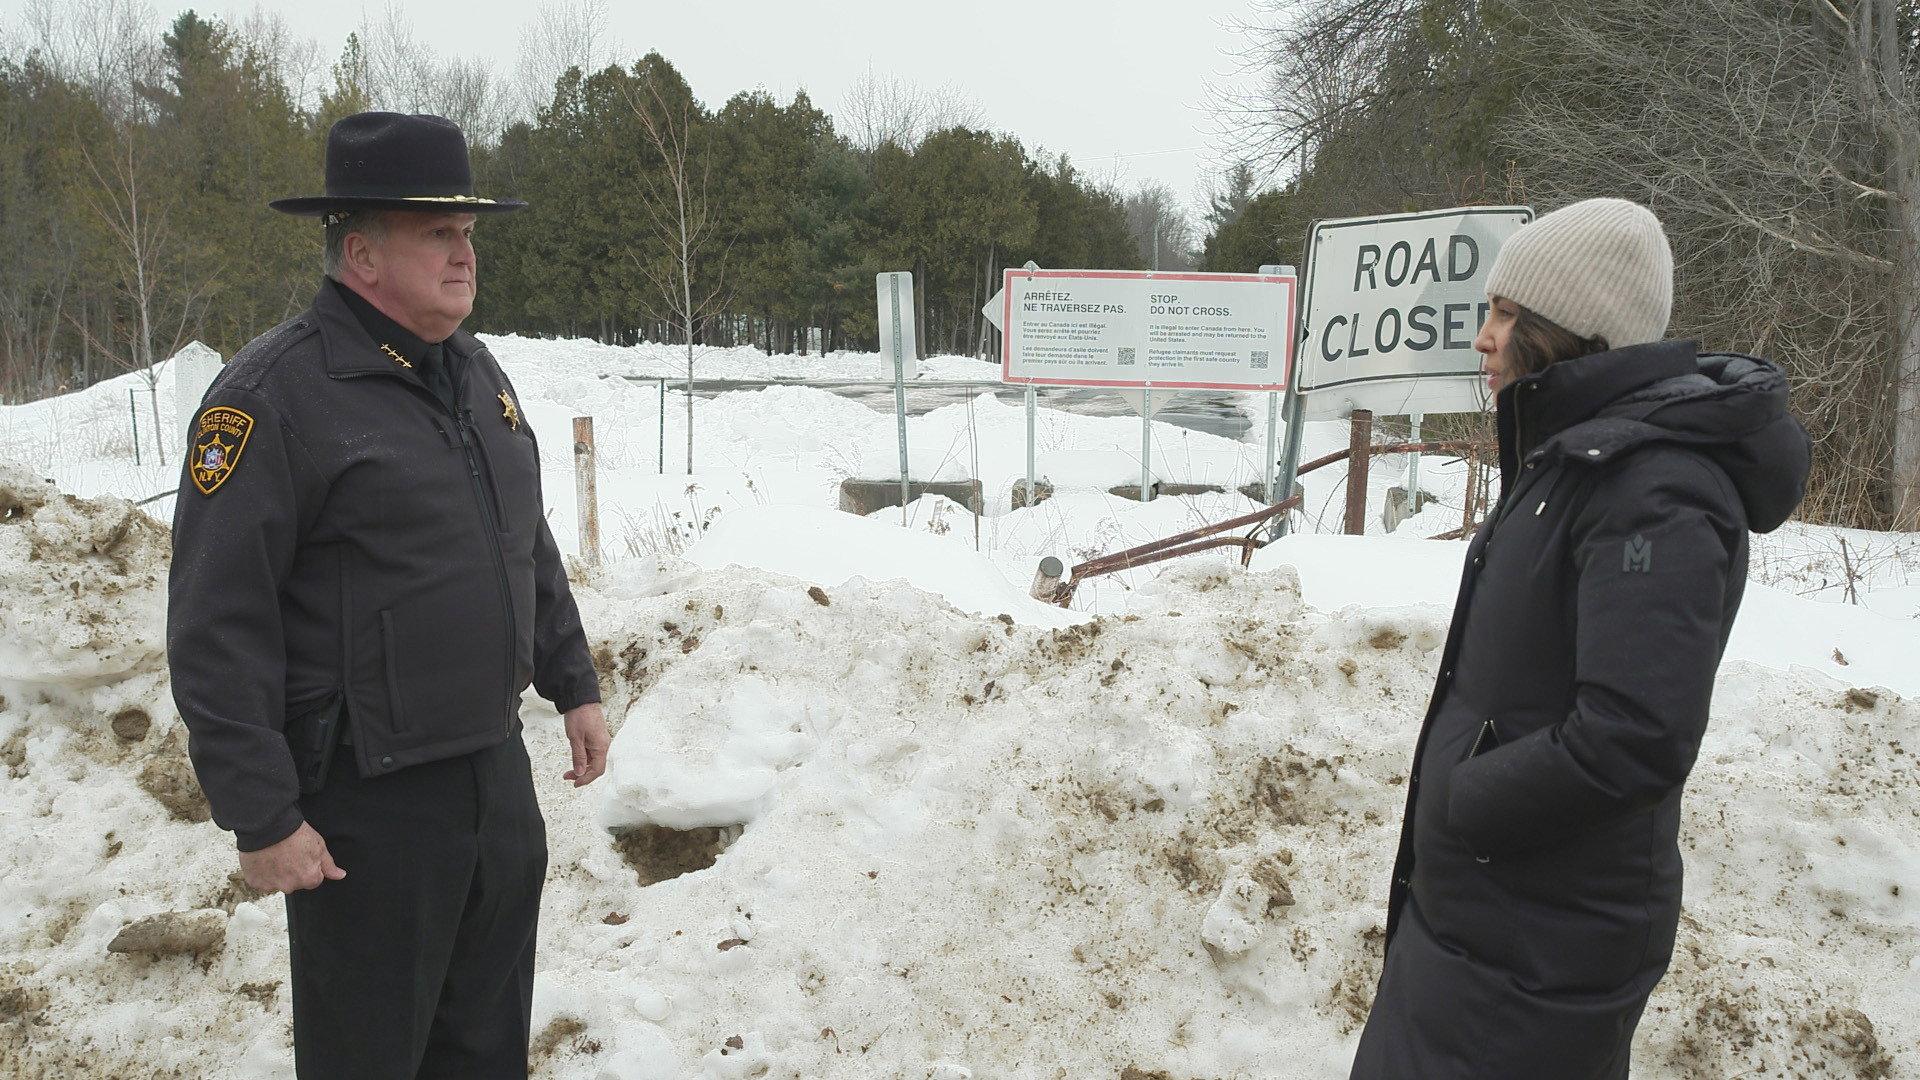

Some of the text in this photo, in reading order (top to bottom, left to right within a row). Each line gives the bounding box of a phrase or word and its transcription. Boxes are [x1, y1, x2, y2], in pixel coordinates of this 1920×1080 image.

[1353, 234, 1480, 292] ROAD
[1023, 290, 1073, 301] ARRÊTEZ.
[1150, 294, 1181, 304] STOP.
[1023, 303, 1127, 314] NE TRAVERSEZ PAS.
[1150, 305, 1233, 317] DO NOT CROSS.
[201, 412, 247, 428] SHERIFF
